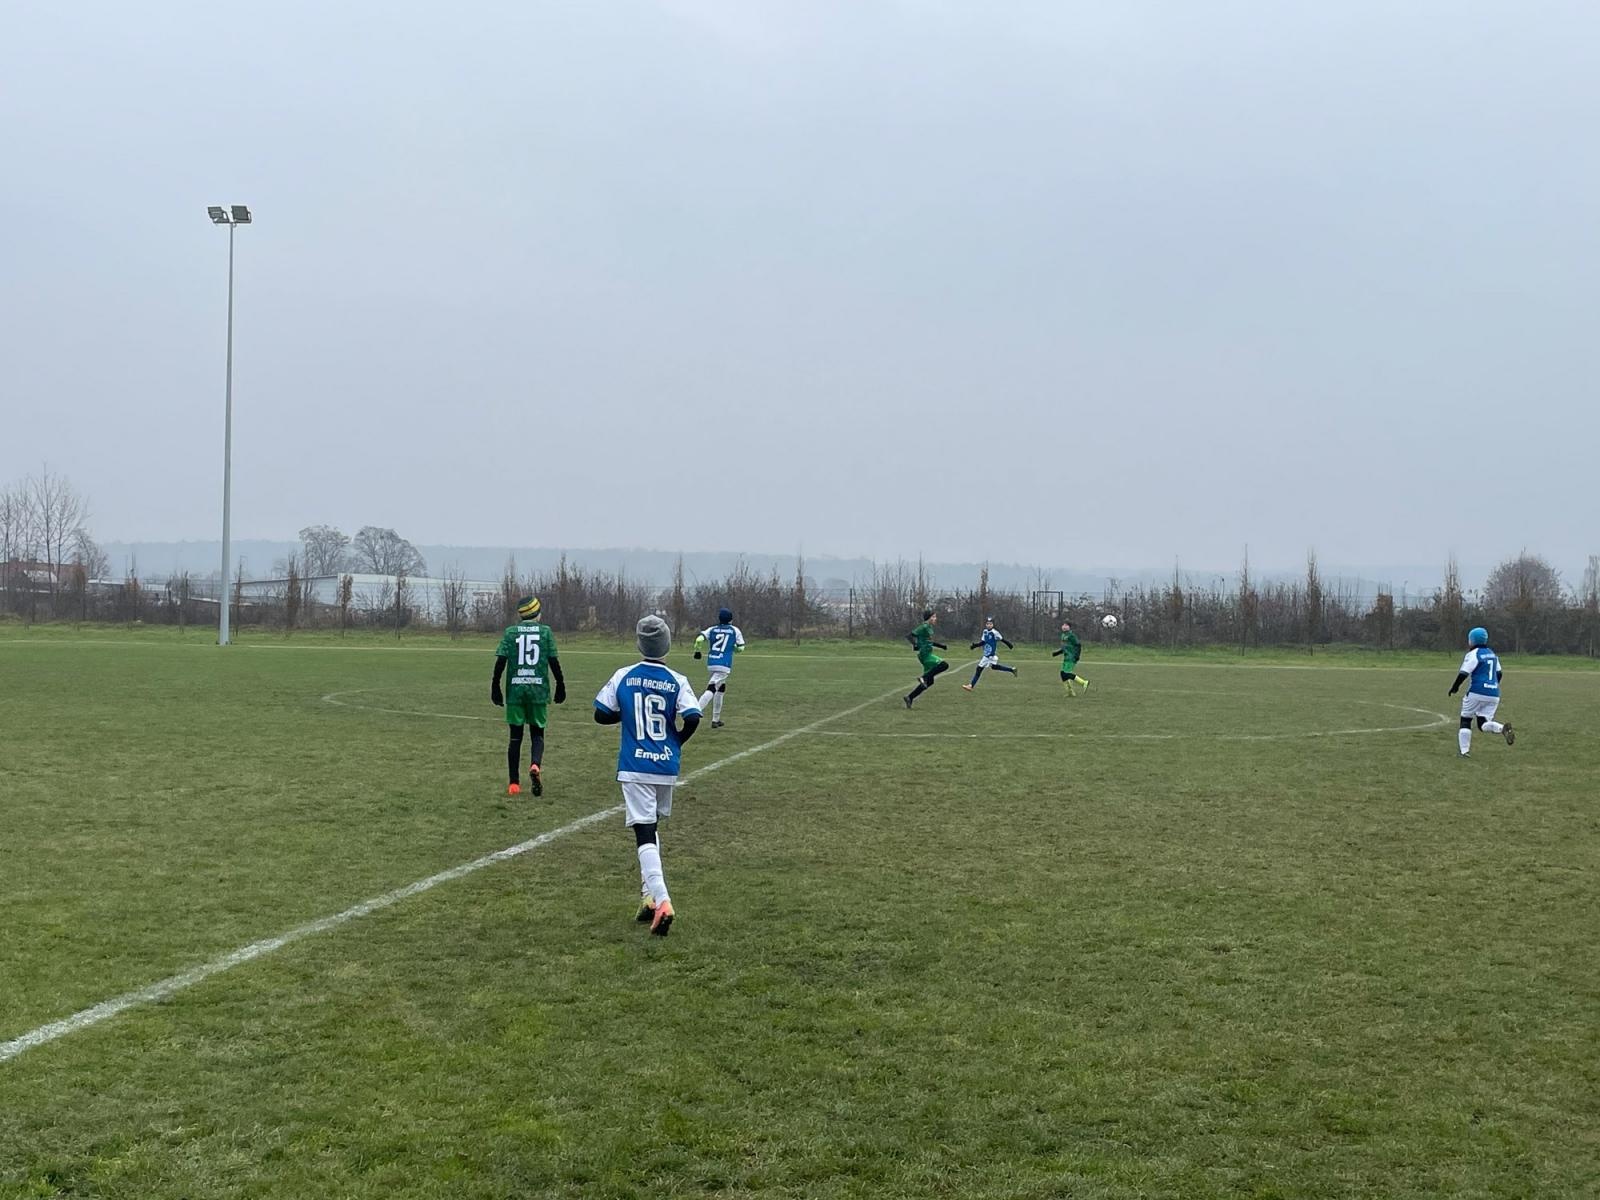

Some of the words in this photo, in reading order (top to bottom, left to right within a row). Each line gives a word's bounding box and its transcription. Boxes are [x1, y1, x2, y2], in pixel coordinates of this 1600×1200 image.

[515, 634, 541, 666] 15
[712, 633, 730, 652] 21
[634, 692, 667, 741] 16
